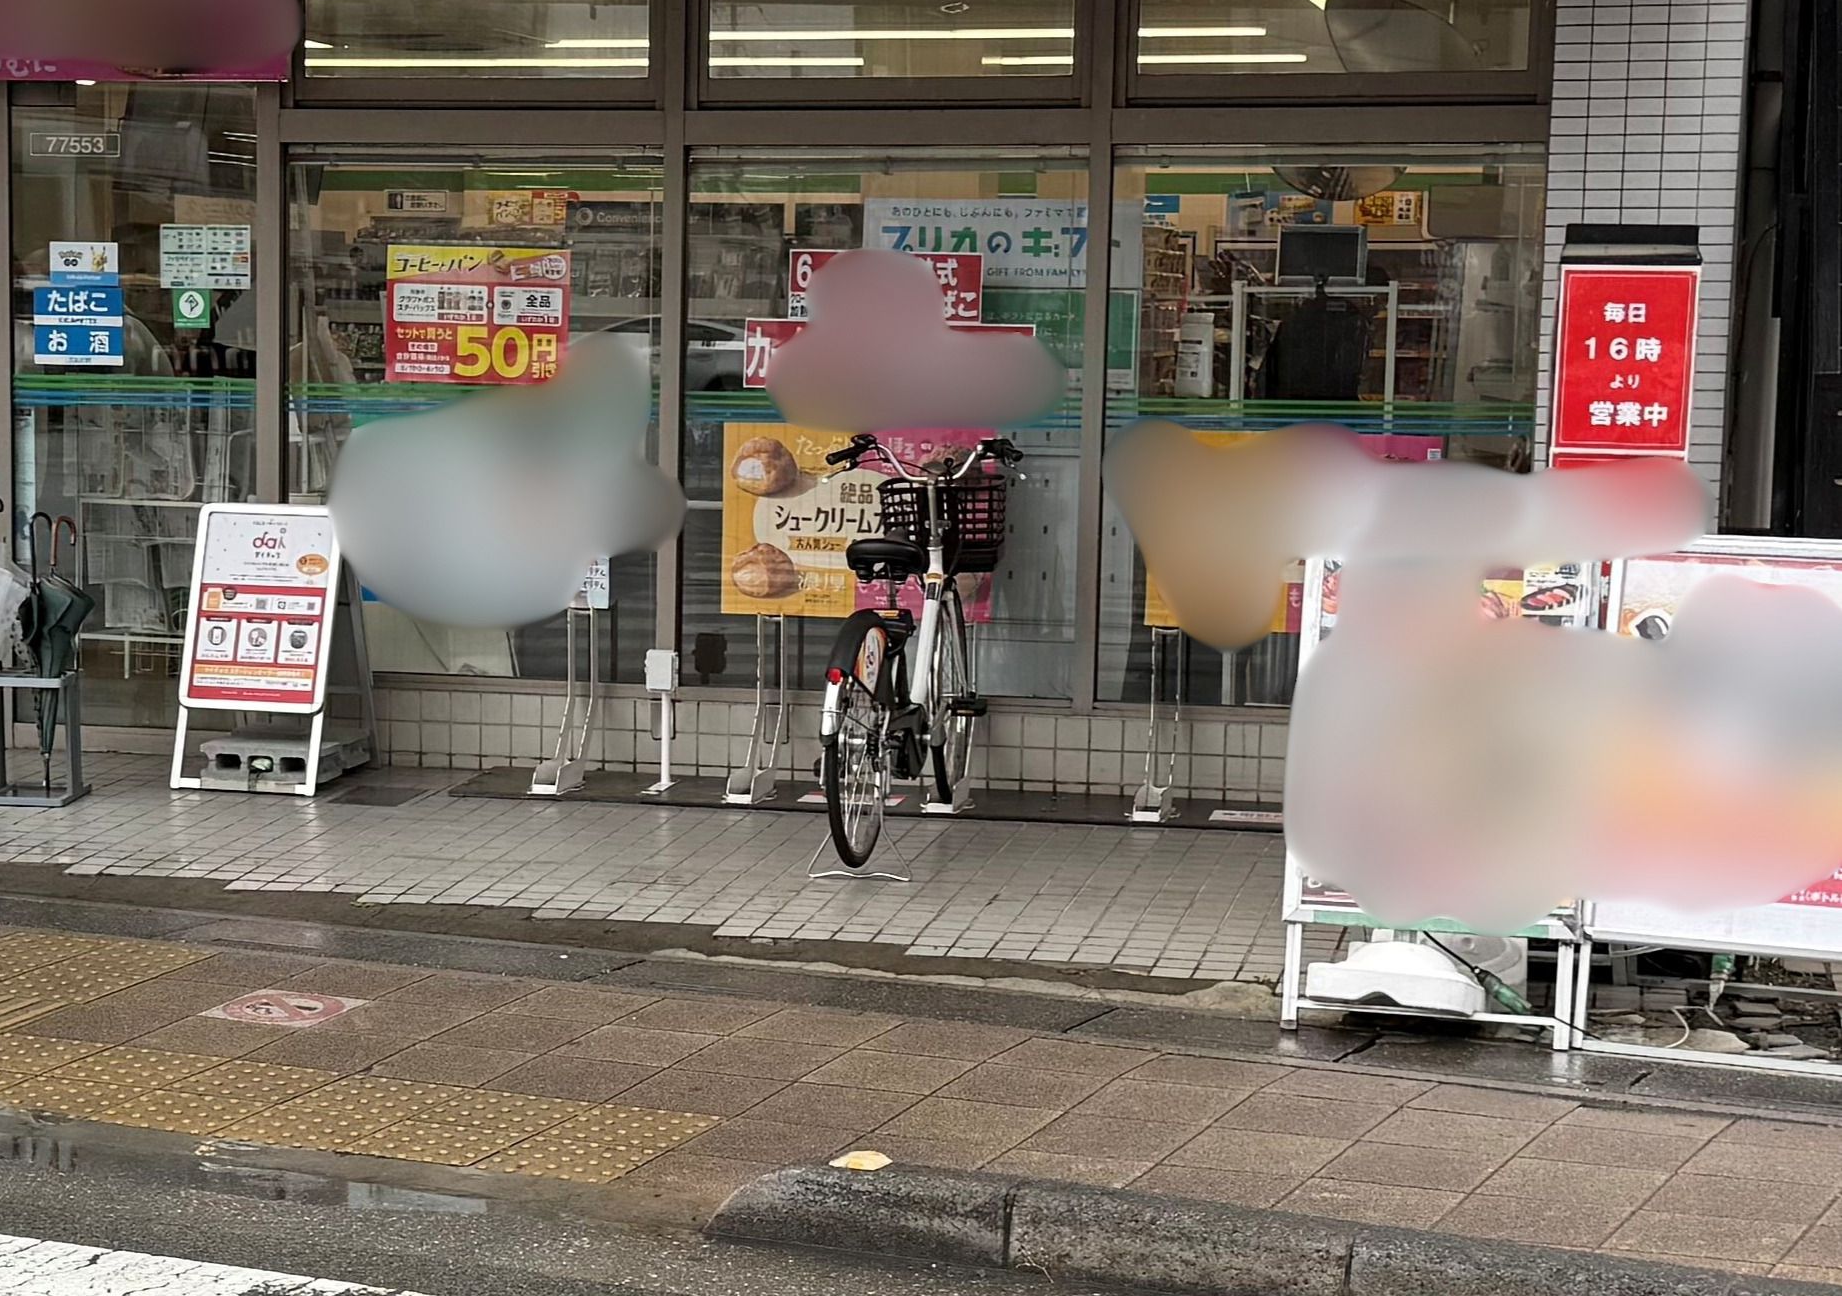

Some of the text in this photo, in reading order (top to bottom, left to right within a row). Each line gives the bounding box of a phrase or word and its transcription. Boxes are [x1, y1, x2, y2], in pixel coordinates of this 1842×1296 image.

[46, 136, 104, 154] 77553
[47, 290, 108, 313] たばこ
[525, 294, 551, 309] 全品
[1603, 302, 1647, 324] 毎日
[454, 325, 530, 378] 50
[1609, 374, 1641, 390] より
[1588, 400, 1669, 428] 営業中
